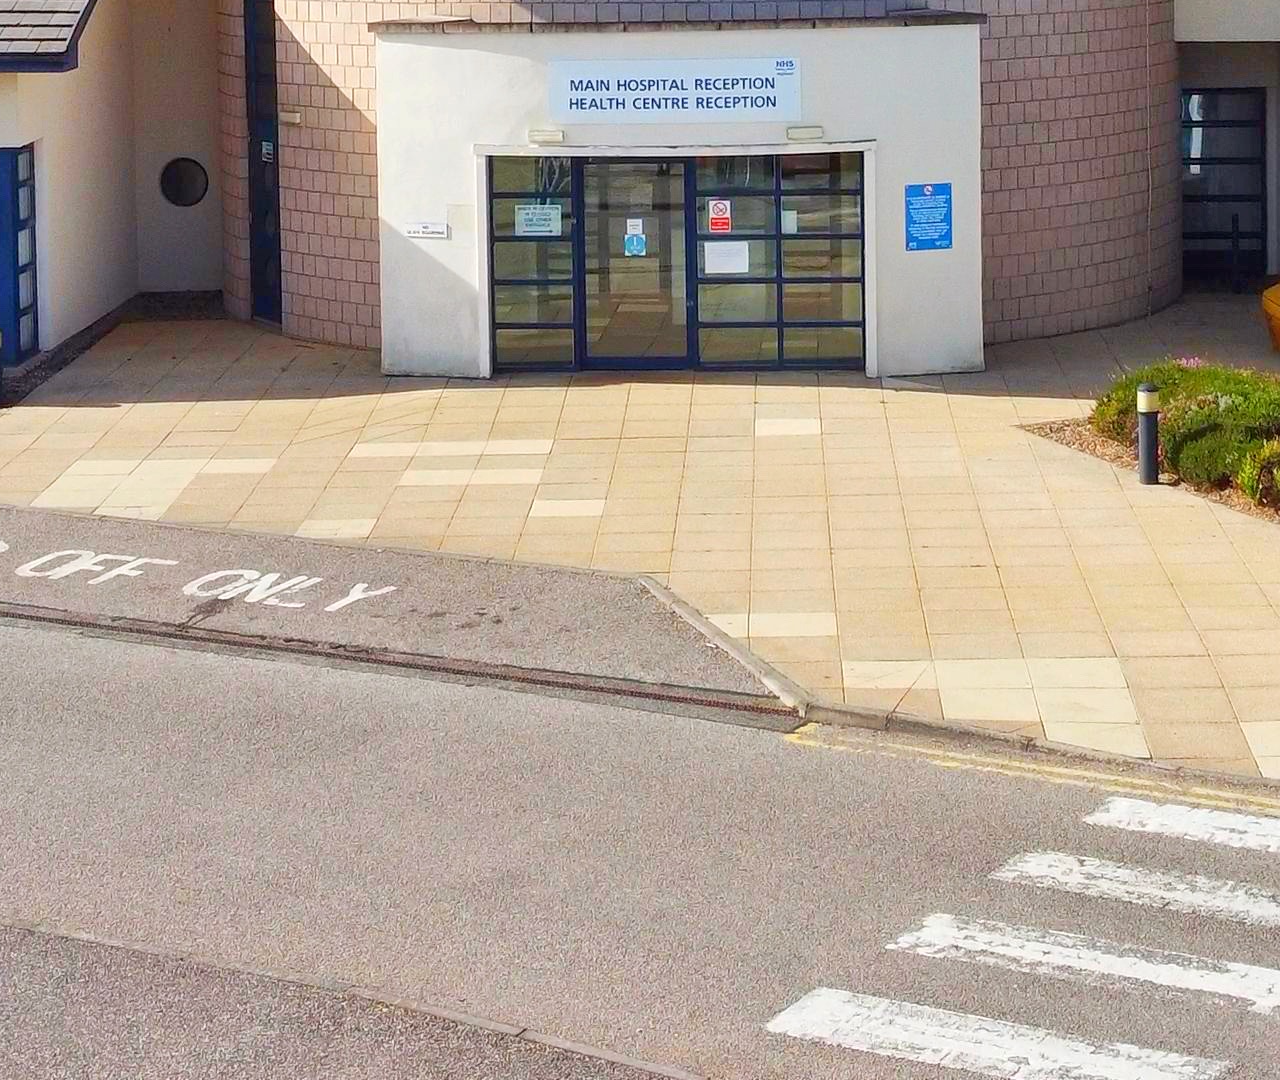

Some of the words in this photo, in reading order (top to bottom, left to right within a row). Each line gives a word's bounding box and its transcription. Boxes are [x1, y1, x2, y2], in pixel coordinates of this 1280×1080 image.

[775, 60, 794, 68] NHS
[570, 79, 610, 92] MAIN
[616, 78, 689, 92] HOSPITAL
[694, 77, 776, 91] RECEPTION
[569, 97, 626, 110] HEALTH
[632, 96, 689, 110] CENTRE
[696, 95, 777, 109] RECEPTION
[14, 549, 180, 586] OFF
[181, 569, 398, 613] ONLY
